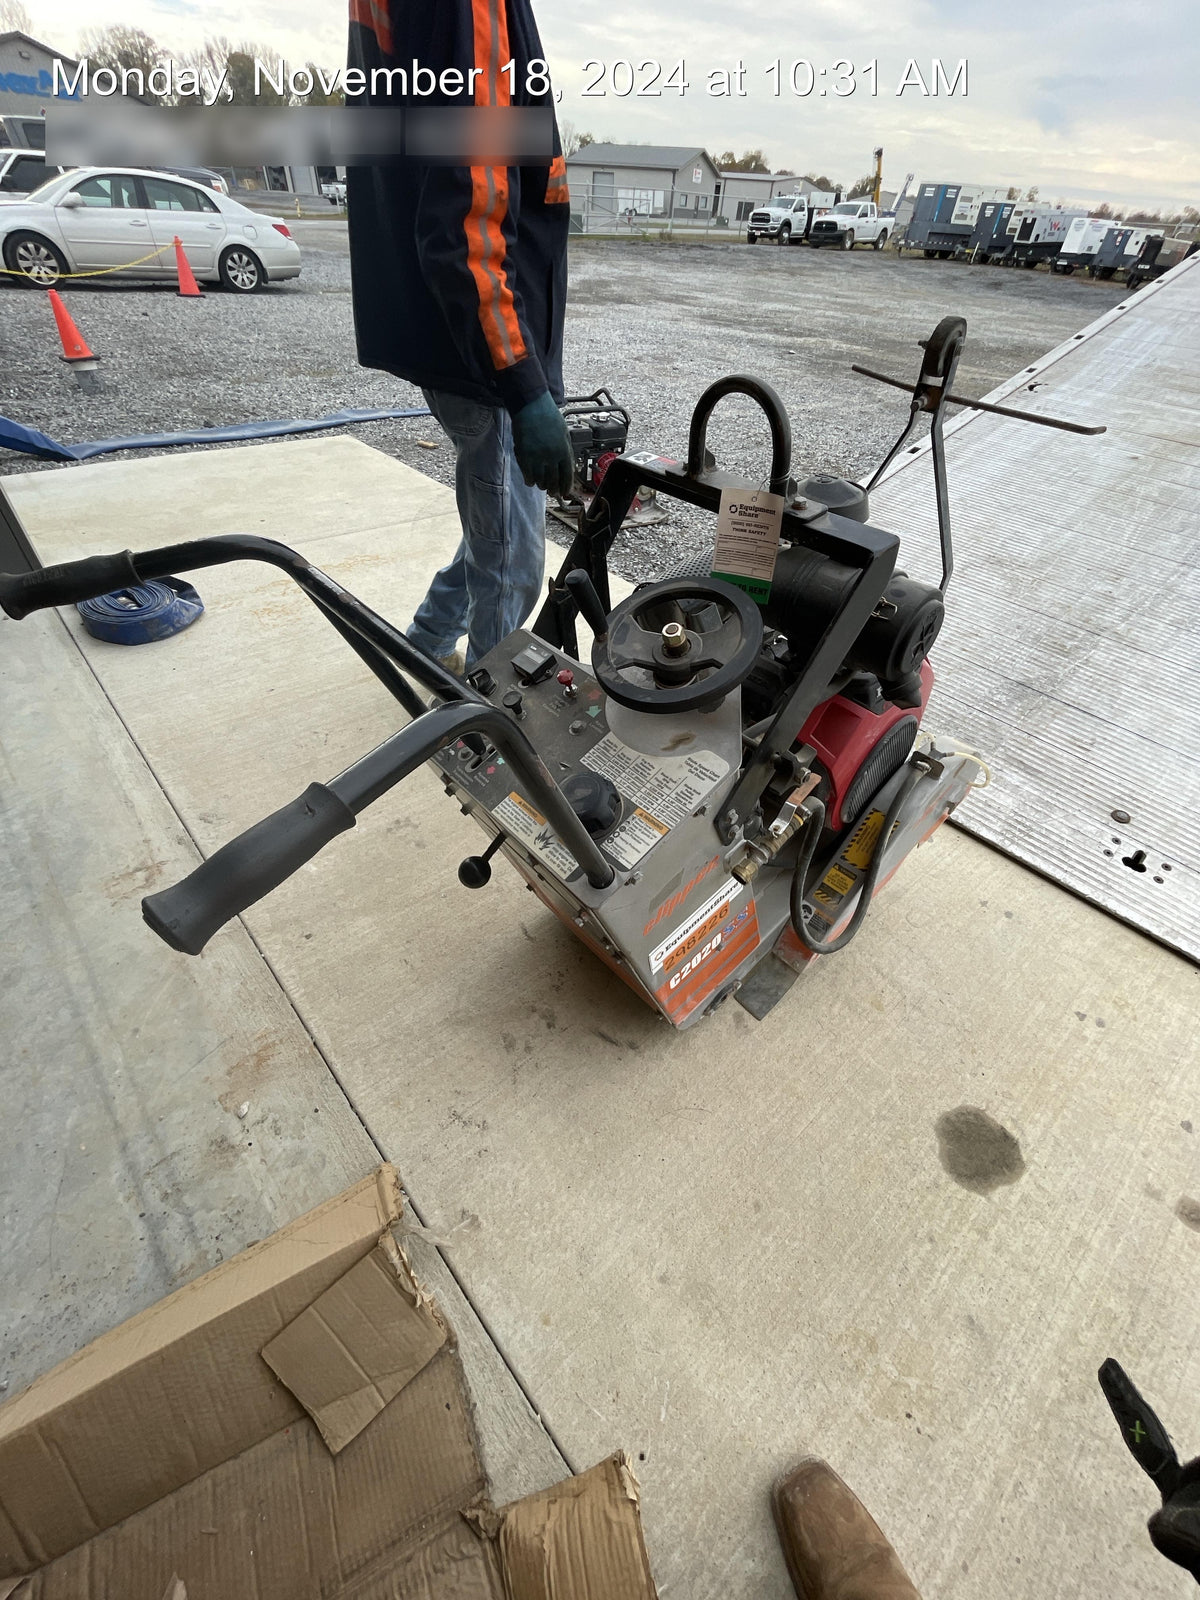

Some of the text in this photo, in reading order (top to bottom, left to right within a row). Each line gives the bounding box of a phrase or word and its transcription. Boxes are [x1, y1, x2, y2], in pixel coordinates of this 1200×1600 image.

[738, 510, 759, 519] Share
[739, 503, 776, 516] Equipment
[748, 586, 769, 595] RENT
[664, 880, 740, 952] EquipmentShare
[665, 905, 729, 971] 298226
[669, 932, 723, 990] C2020
